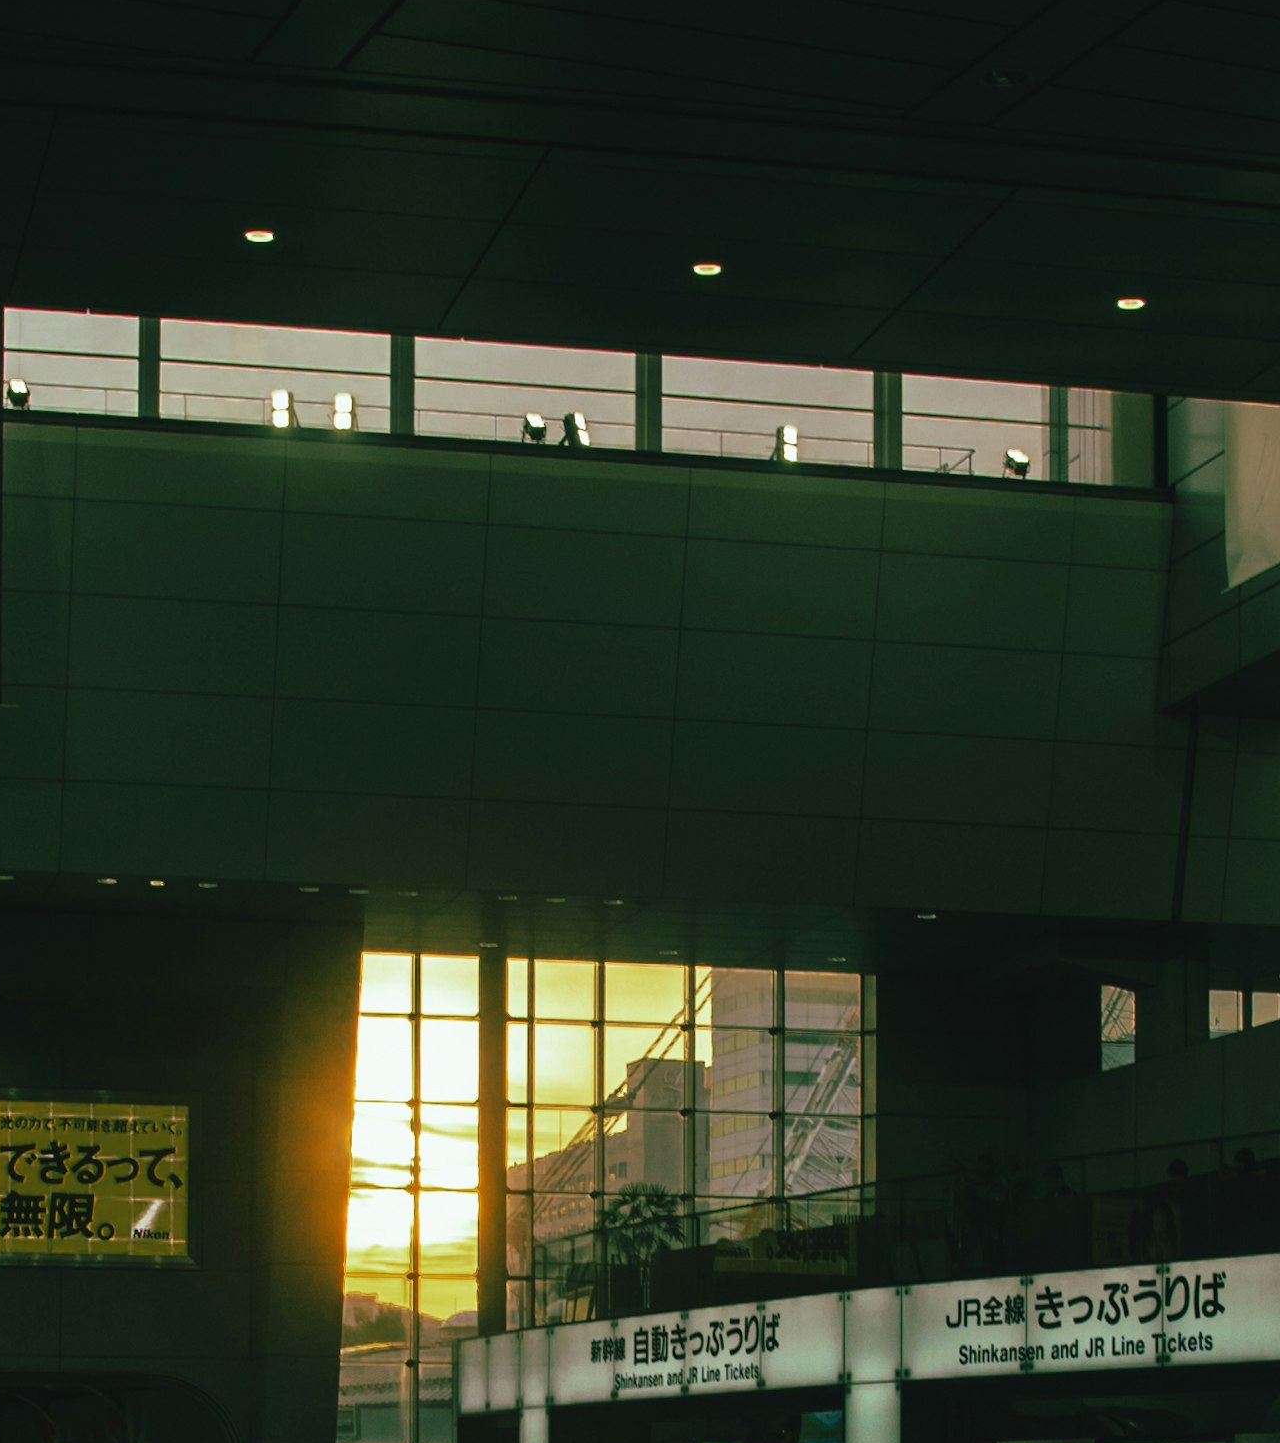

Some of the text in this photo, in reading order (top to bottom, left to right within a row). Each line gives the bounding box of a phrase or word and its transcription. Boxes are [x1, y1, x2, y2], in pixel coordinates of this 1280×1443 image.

[0, 1141, 184, 1189] できるって、
[0, 1189, 115, 1241] 無限。
[133, 1228, 170, 1240] Nikon
[946, 1271, 1227, 1330] JR全線 きっぷうりば
[634, 1312, 781, 1366] 自動きっぷうりば
[958, 1331, 1214, 1366] Shinkansen and JR Line Tickets
[614, 1362, 760, 1391] Shinkansen and JR Line Tickets
